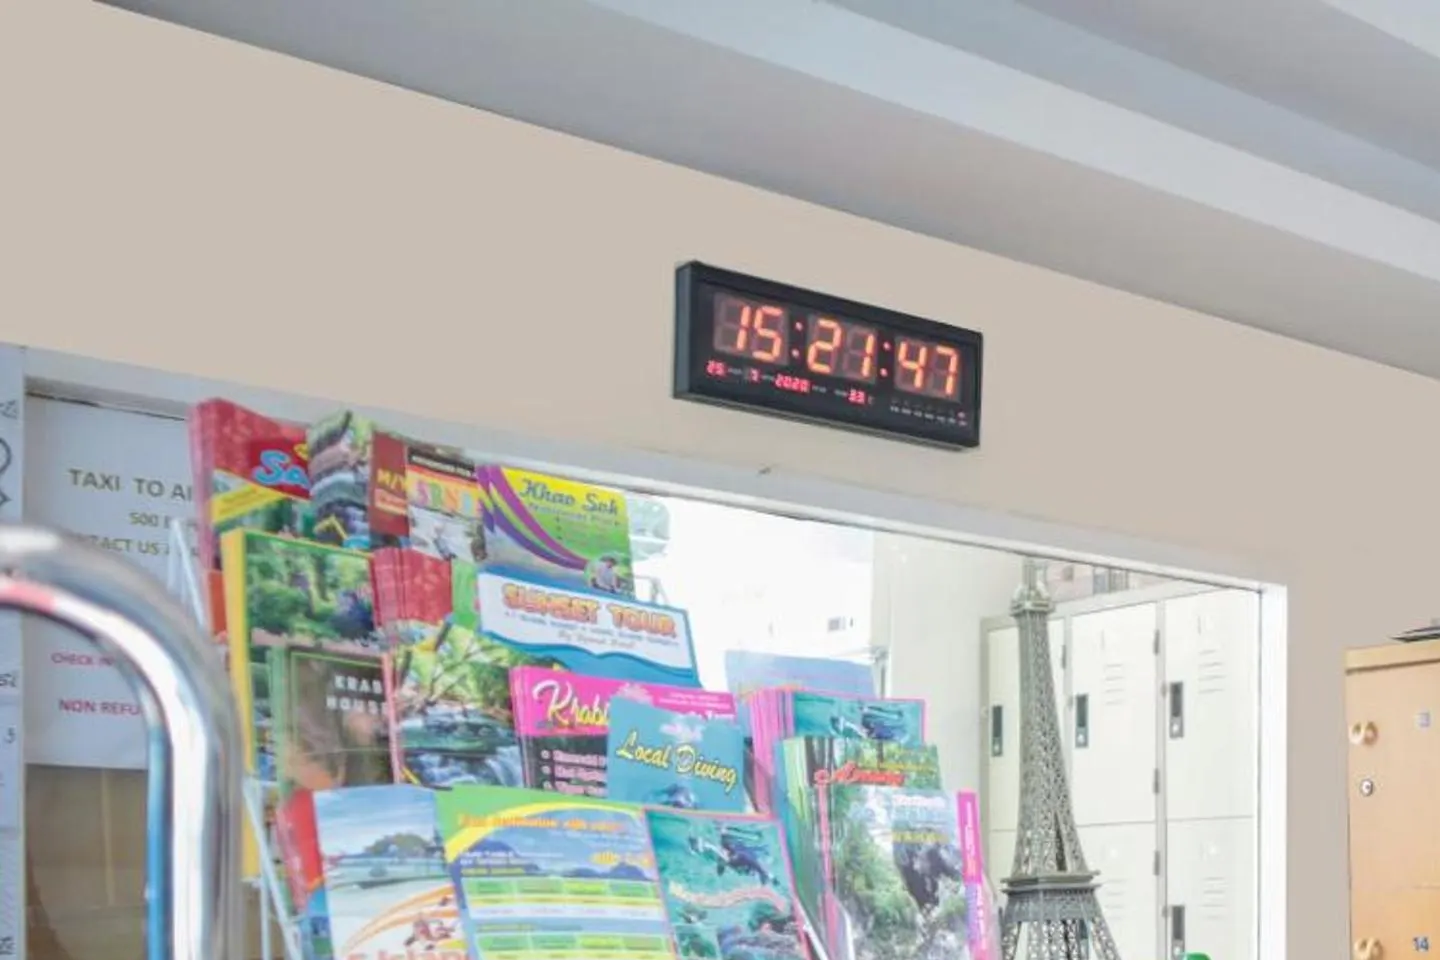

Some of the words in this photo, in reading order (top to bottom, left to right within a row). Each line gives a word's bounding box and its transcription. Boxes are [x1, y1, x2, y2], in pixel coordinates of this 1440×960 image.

[735, 305, 959, 395] 15:21:47
[68, 468, 121, 492] TAXI
[132, 478, 165, 498] TO
[59, 699, 97, 713] NON
[615, 731, 671, 769] Local
[676, 744, 737, 793] Diving
[1413, 936, 1430, 952] 14
